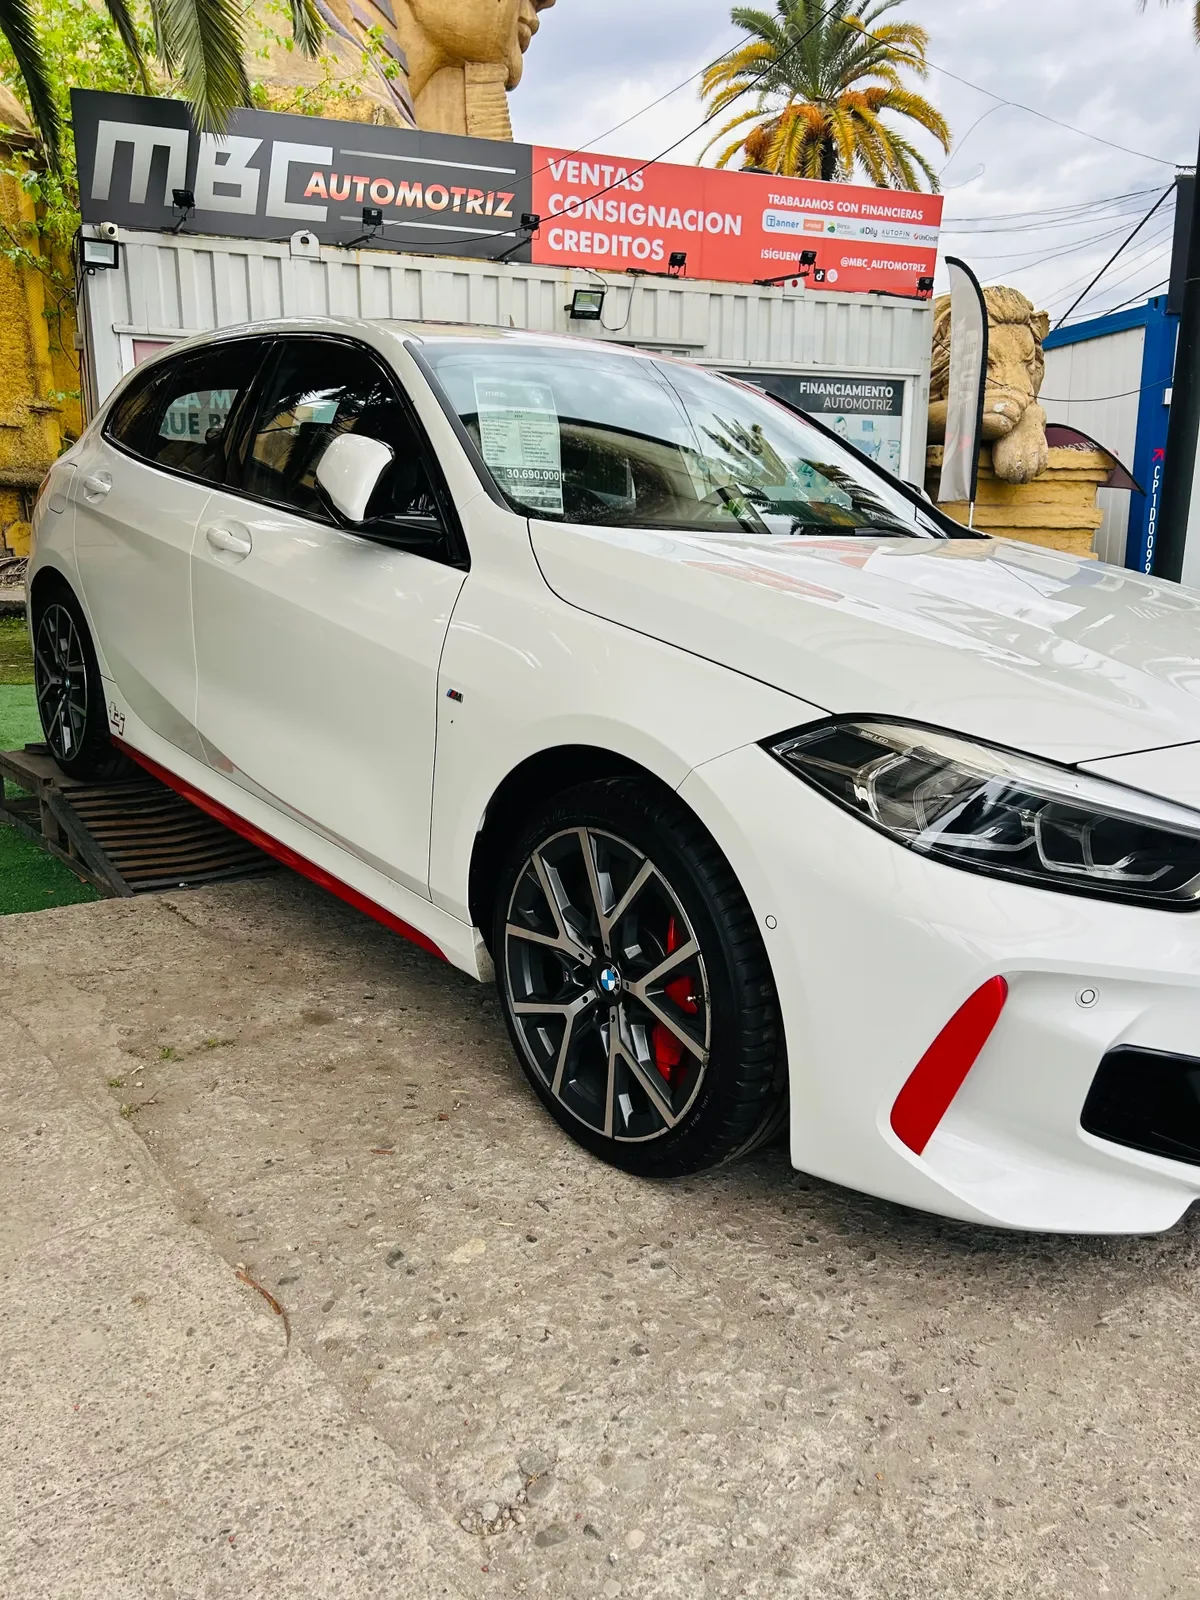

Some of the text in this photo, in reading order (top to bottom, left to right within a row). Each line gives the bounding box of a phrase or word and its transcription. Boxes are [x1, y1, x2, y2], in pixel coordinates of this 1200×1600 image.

[91, 120, 333, 222] MBC
[547, 158, 644, 193] VENTAS
[303, 171, 515, 218] AUTOMOTRIZ
[547, 193, 742, 236] CONSIGNACION
[767, 193, 924, 220] TRABAJAMOS CON FINANCIERAS
[766, 215, 800, 229] Tanner
[881, 228, 910, 237] AUTOFIN
[547, 228, 664, 261] CREDITOS
[840, 257, 926, 272] @MBC_AUTOMOTRIZ
[799, 381, 894, 398] FINANCIAMIENTO
[823, 396, 893, 411] AUTOMOTRIZ
[506, 469, 559, 480] 30.690.000
